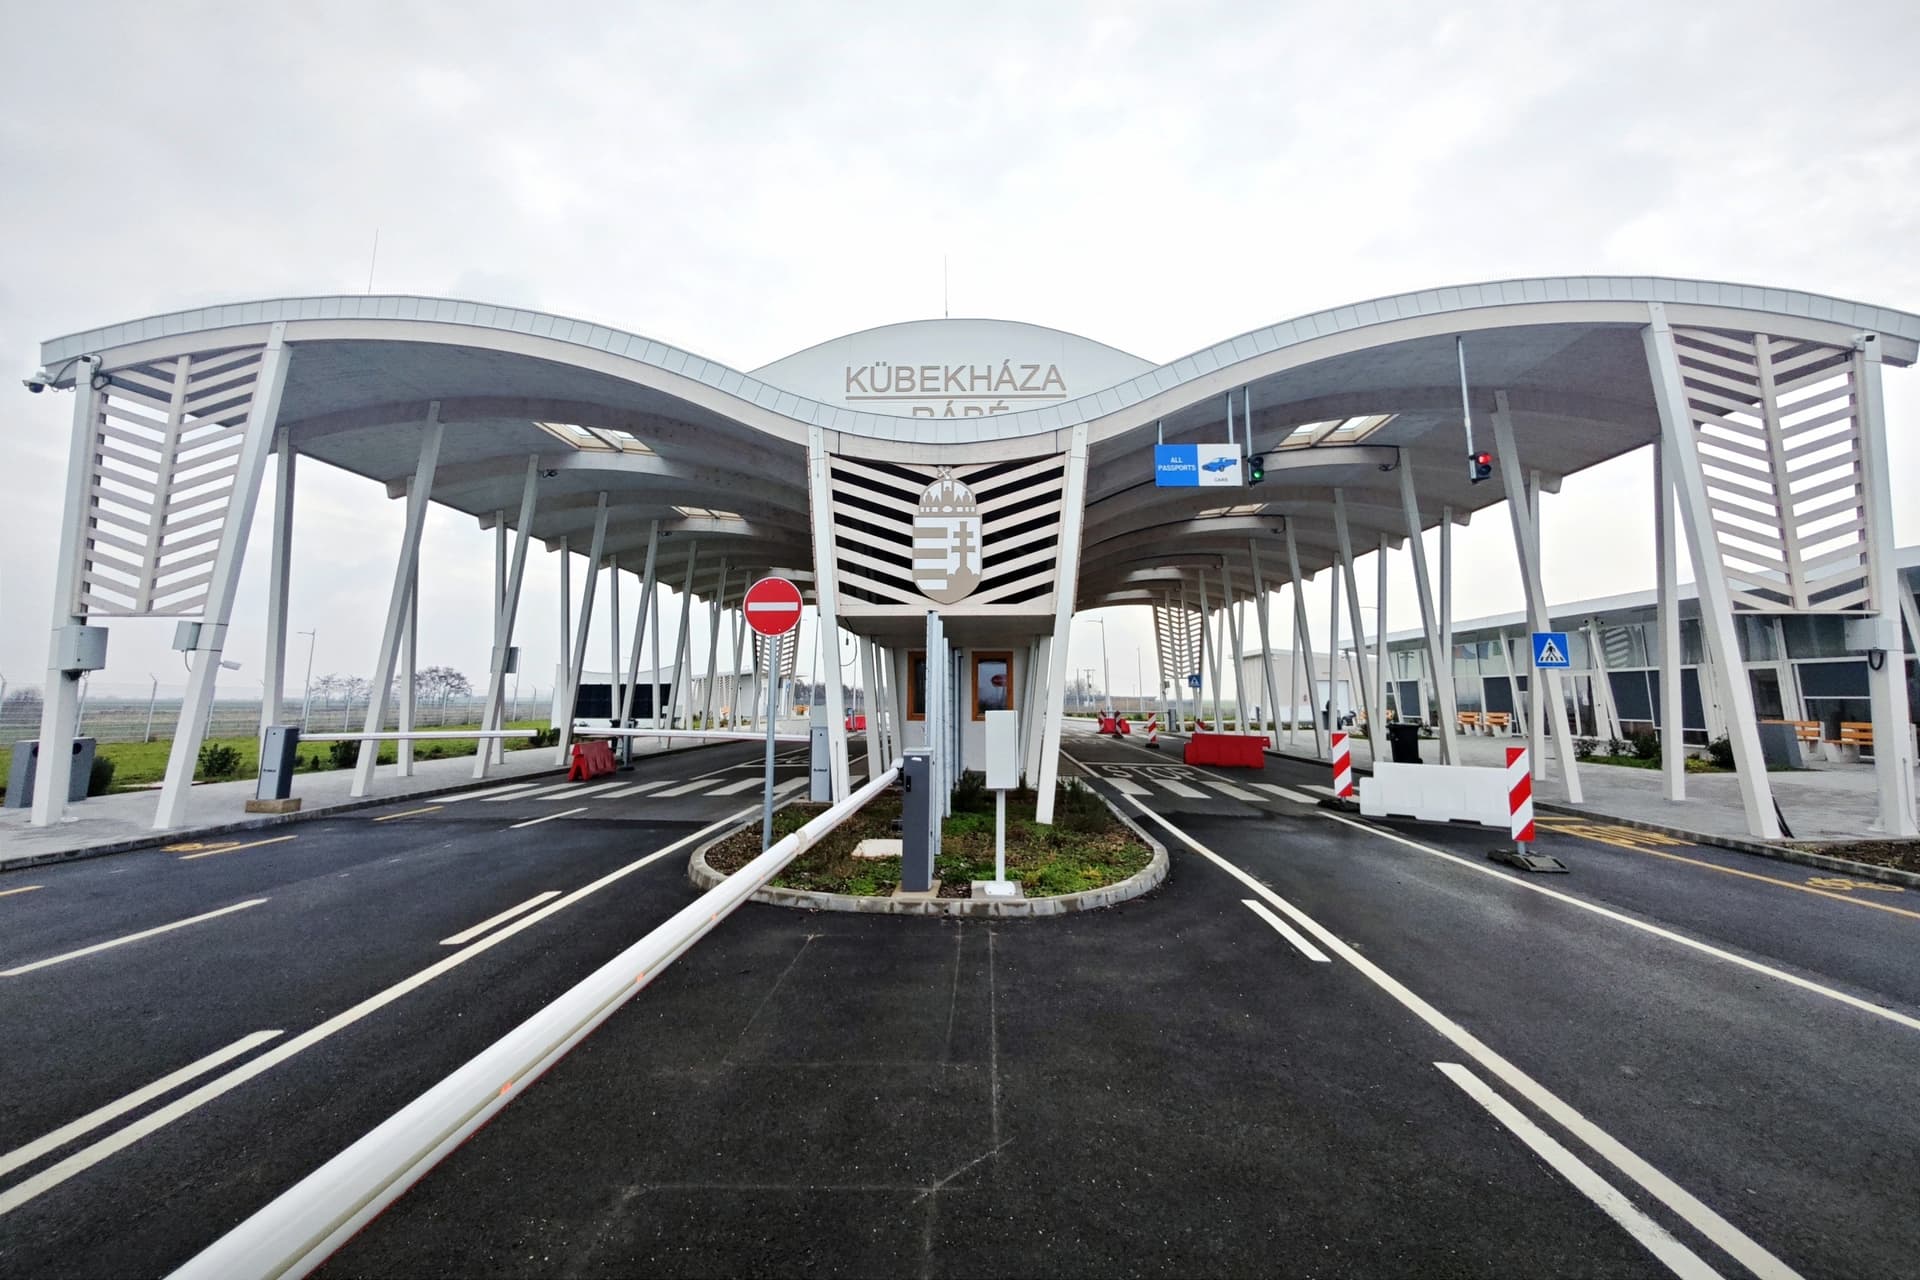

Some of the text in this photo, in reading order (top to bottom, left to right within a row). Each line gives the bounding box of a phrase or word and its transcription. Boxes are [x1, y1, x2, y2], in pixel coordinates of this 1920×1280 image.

[846, 359, 1066, 393] KÜBEKHÁZA
[1158, 464, 1196, 472] PASSPORTS
[1102, 765, 1197, 781] STOP
